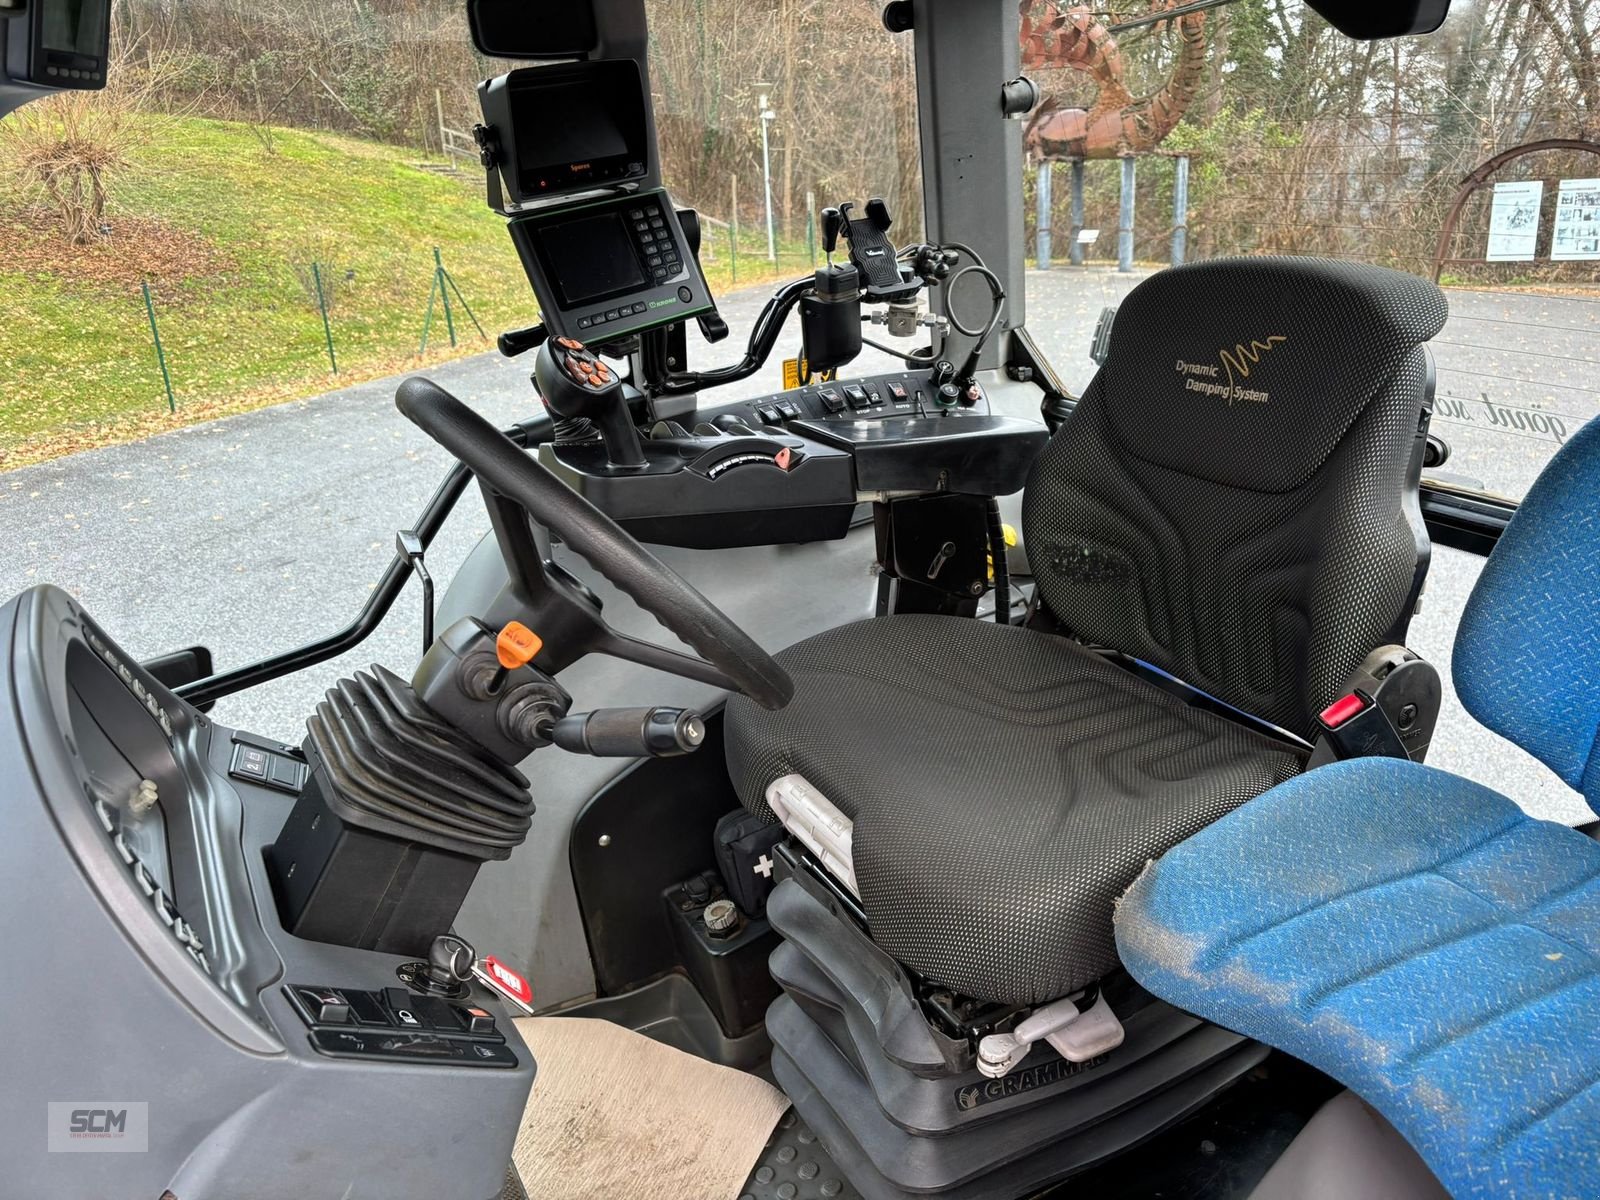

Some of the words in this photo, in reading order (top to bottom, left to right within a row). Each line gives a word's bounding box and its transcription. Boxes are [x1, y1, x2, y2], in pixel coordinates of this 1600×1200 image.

[1176, 360, 1219, 376] Dynamic
[1186, 379, 1230, 398] Damping
[1233, 386, 1269, 402] System
